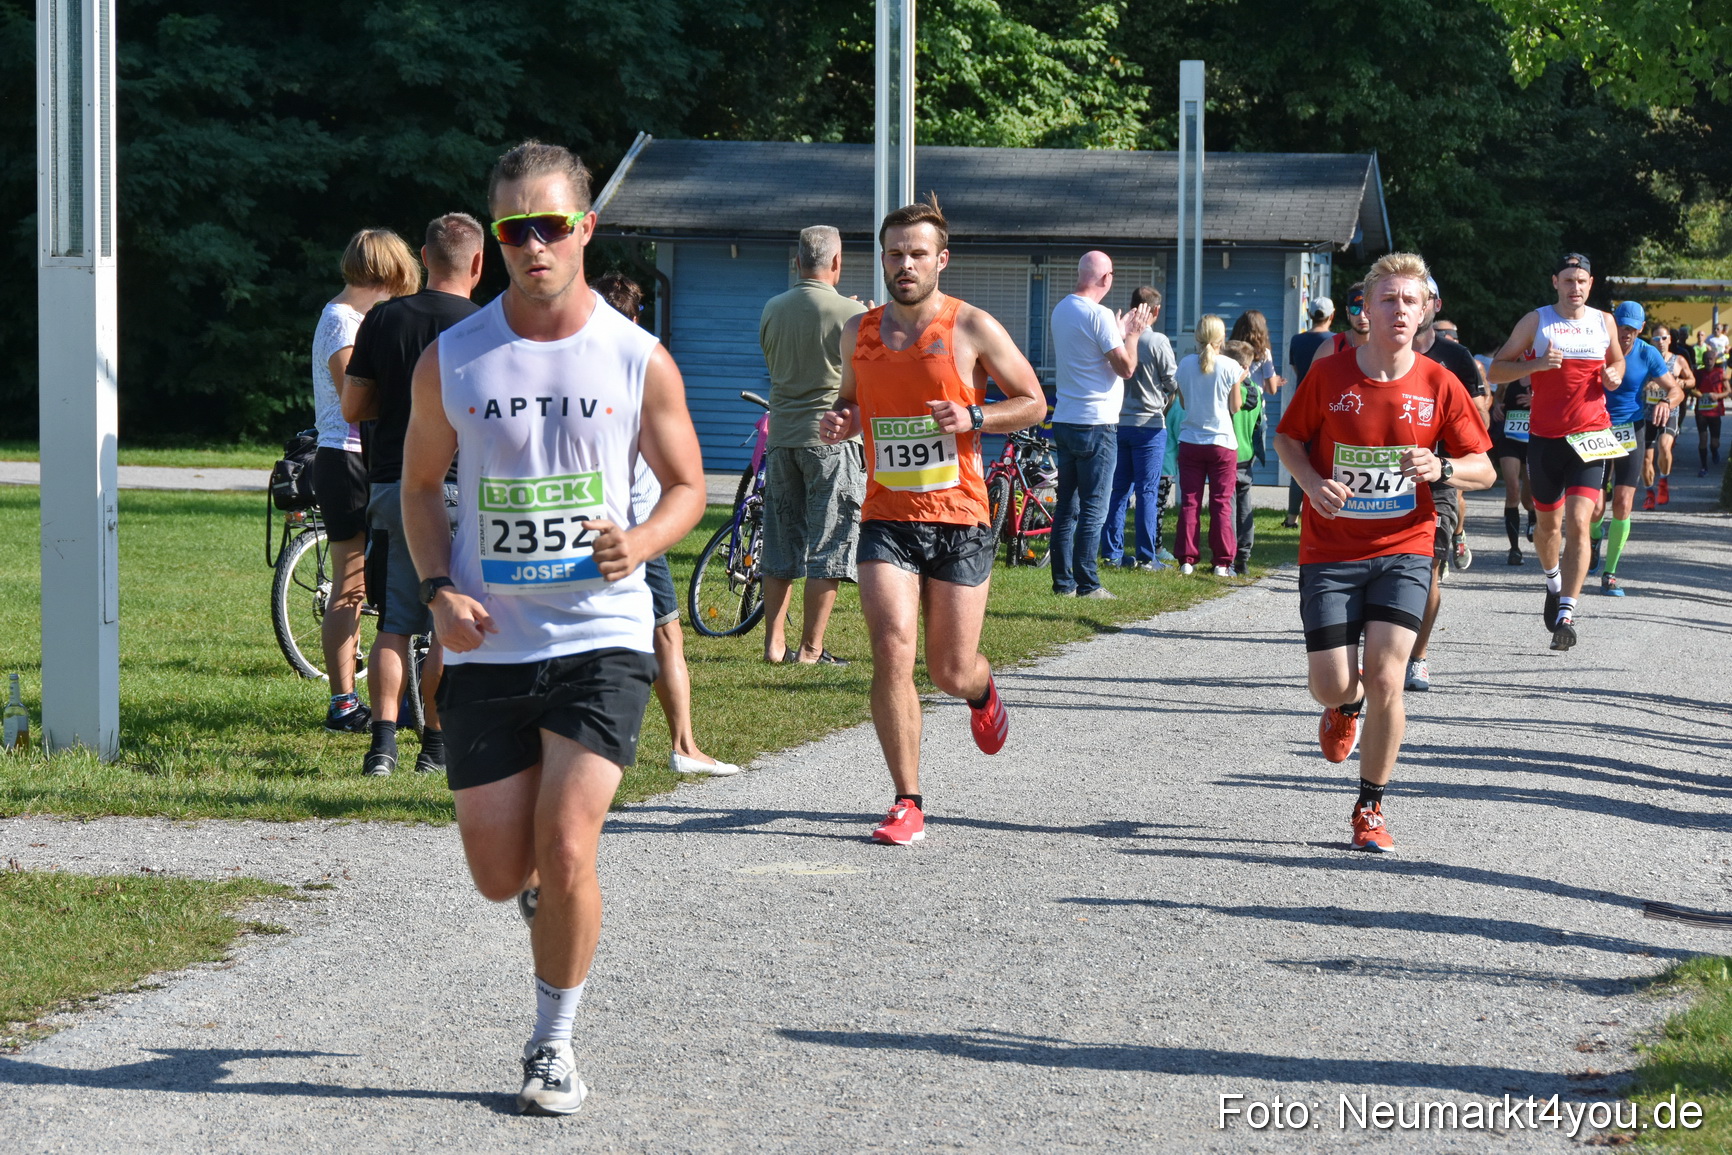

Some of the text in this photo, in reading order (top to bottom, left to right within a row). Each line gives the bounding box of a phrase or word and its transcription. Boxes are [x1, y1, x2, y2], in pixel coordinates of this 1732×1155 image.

[484, 397, 598, 419] APTIV
[1328, 402, 1350, 413] Spitz
[883, 440, 945, 467] 1391
[1579, 437, 1614, 452] 1084
[484, 477, 595, 508] BOCK
[1342, 470, 1406, 493] 2247
[1347, 500, 1400, 511] MANUEL
[491, 515, 593, 553] 2352
[511, 563, 576, 581] JOSEF
